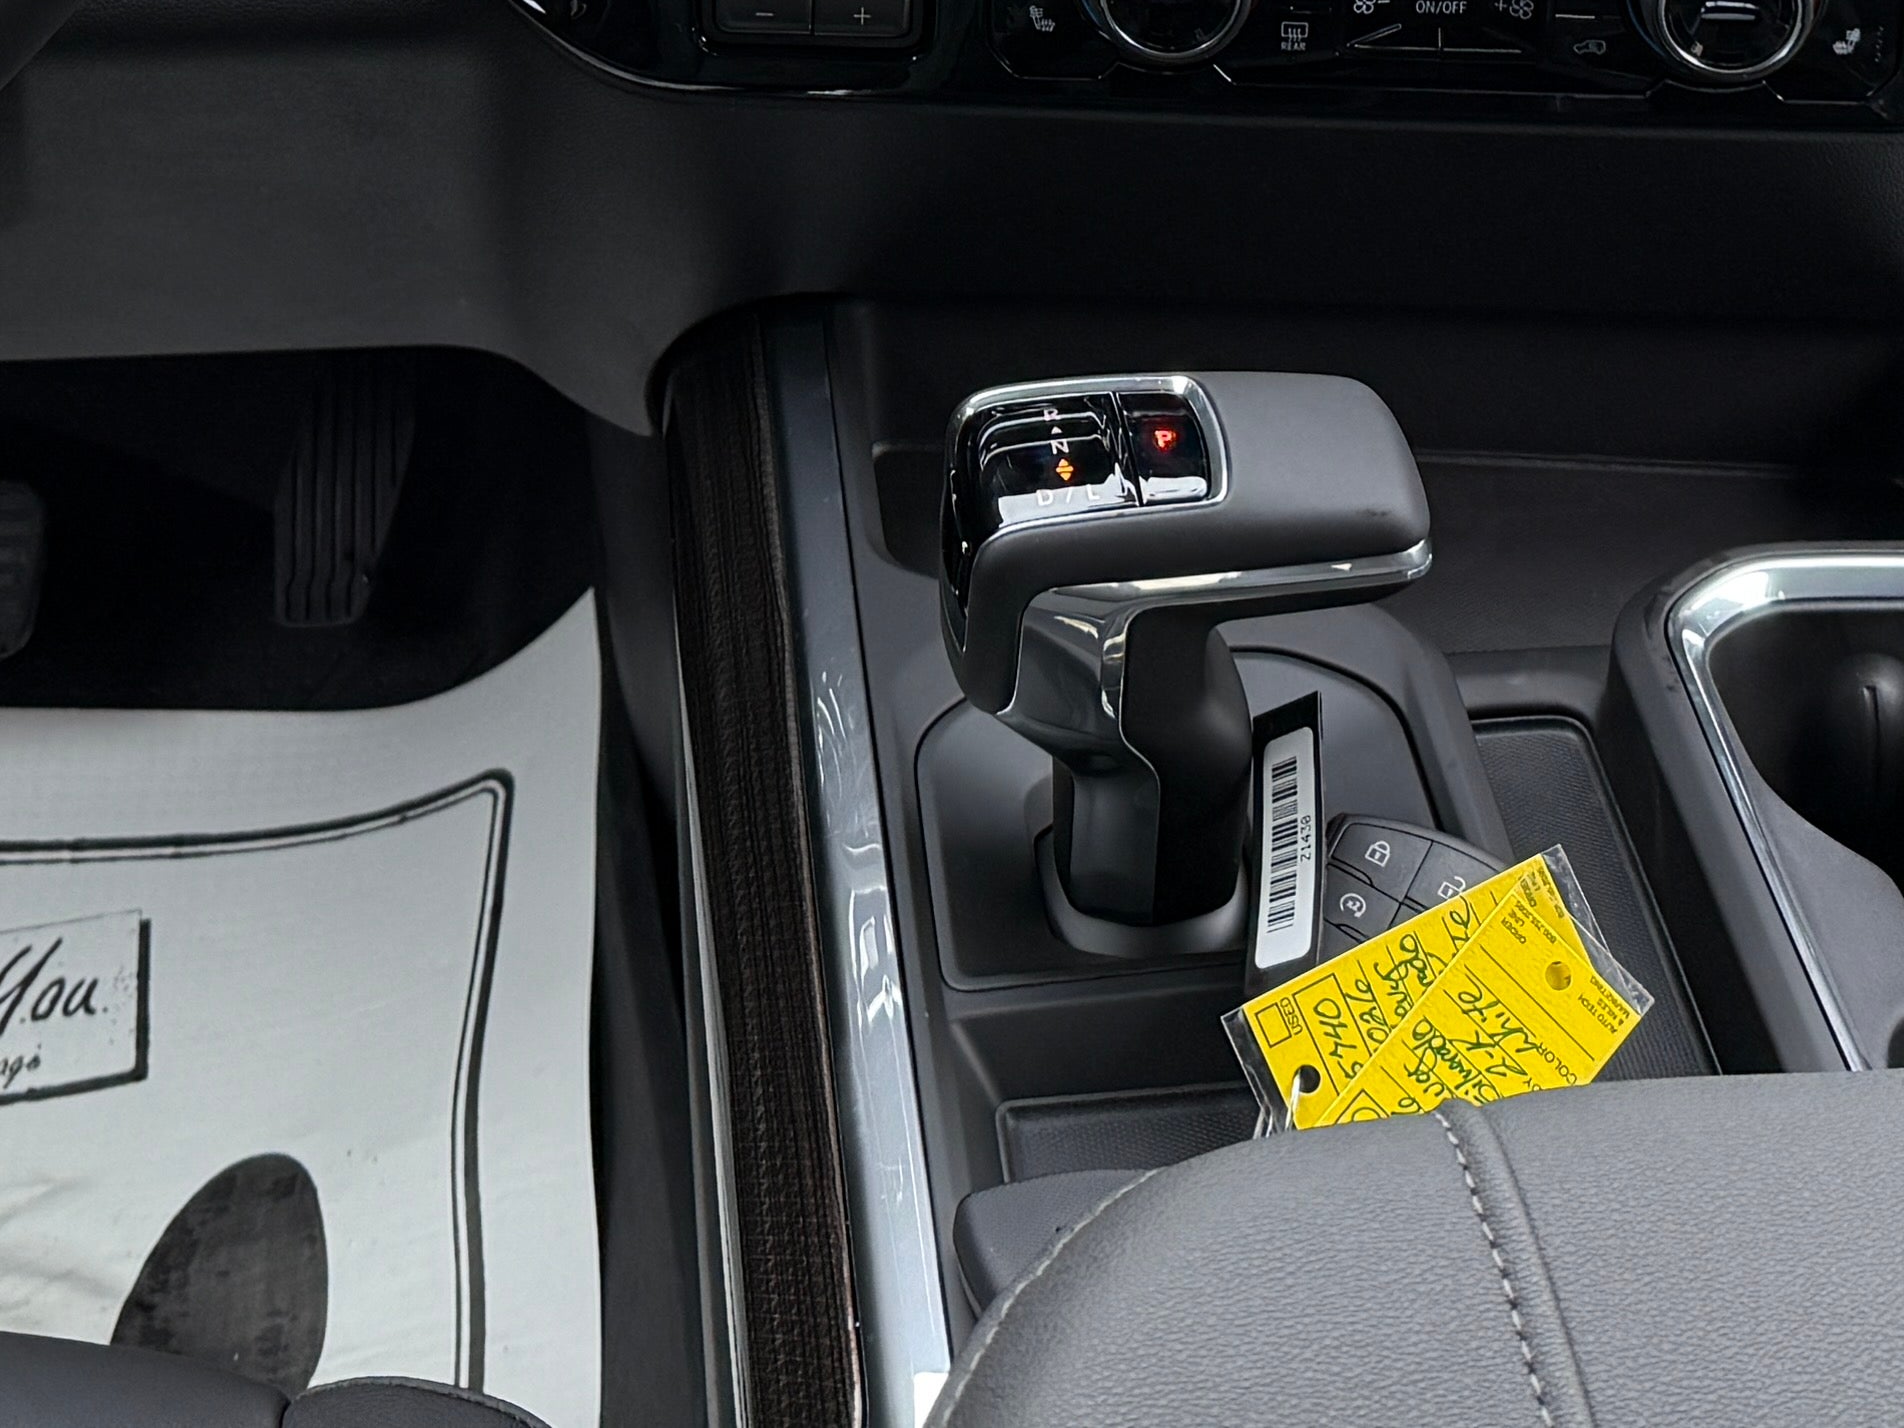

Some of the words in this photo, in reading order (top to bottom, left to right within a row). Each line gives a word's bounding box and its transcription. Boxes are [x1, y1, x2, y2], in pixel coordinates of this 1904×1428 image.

[1415, 0, 1467, 15] ON/OFF
[1051, 440, 1071, 456] N
[1154, 430, 1178, 451] P
[1300, 813, 1313, 863] 21430
[1280, 997, 1303, 1036] USED
[1346, 977, 1392, 1053] 026
[1537, 1042, 1578, 1086] COLOR
